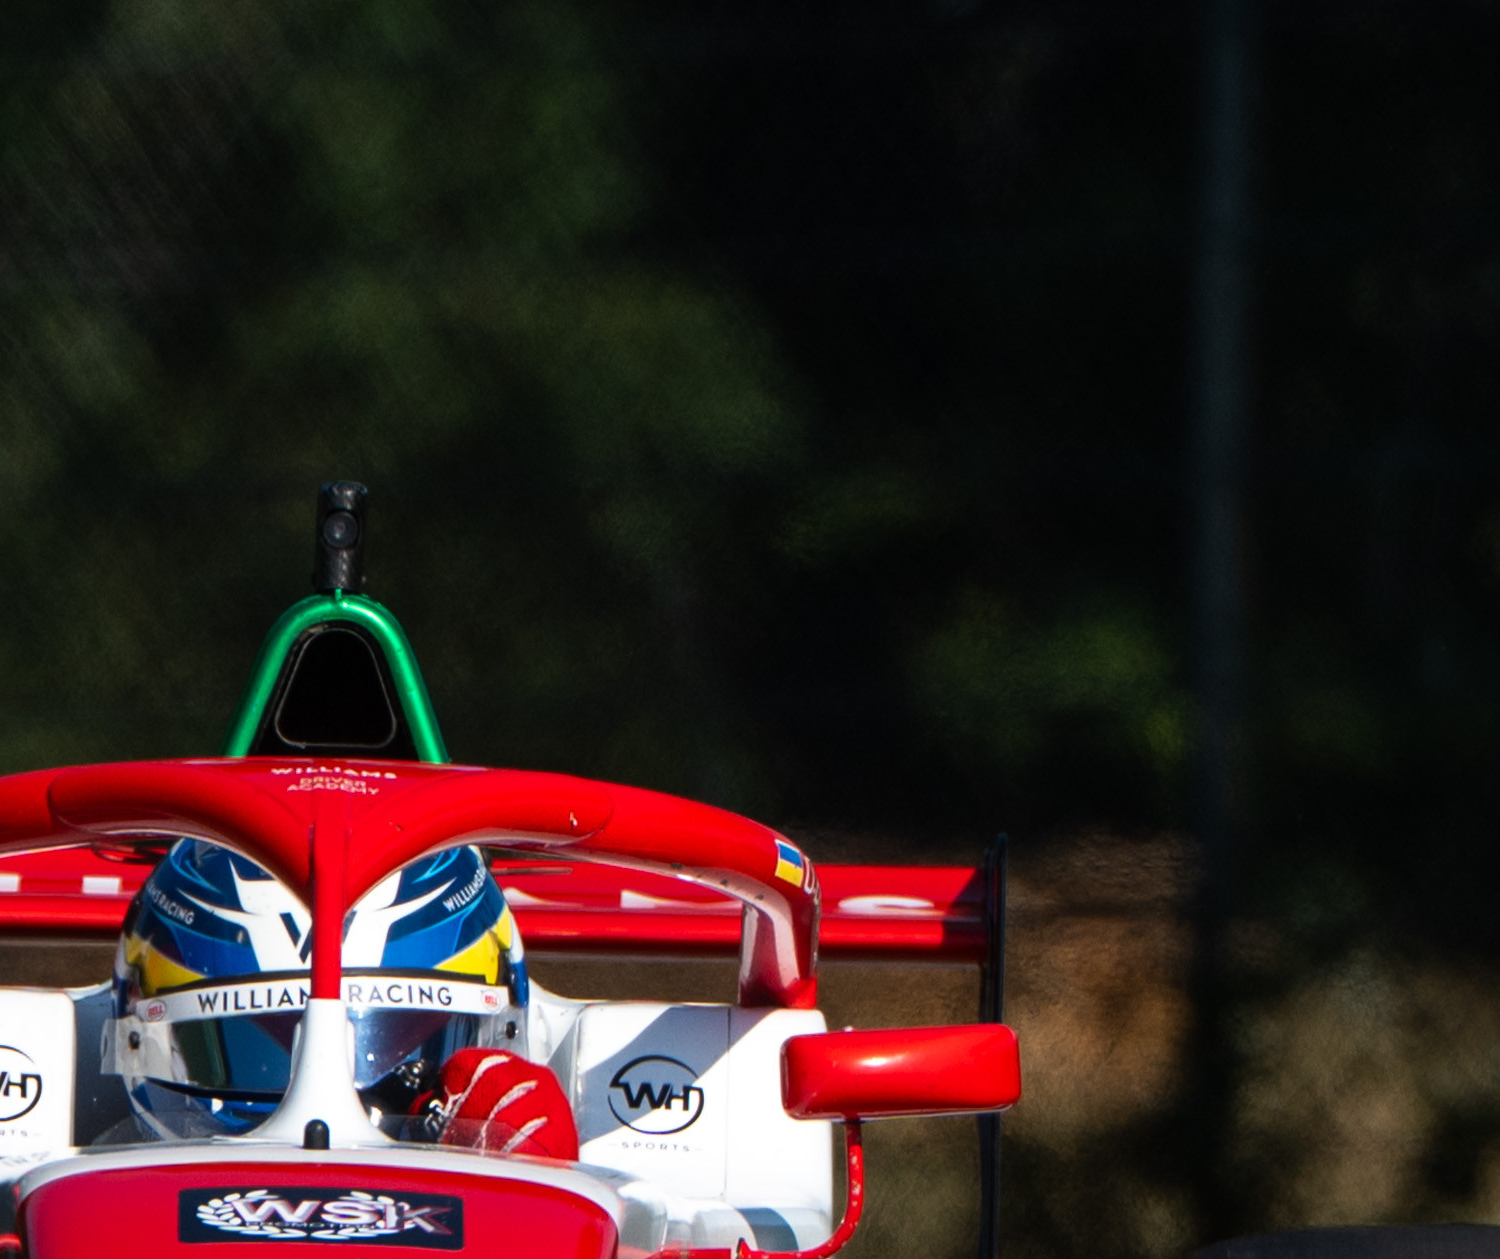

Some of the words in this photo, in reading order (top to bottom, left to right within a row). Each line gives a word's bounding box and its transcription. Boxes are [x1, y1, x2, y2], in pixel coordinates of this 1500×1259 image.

[271, 766, 397, 779] WILLIAMS
[300, 776, 367, 788] DRIVER
[287, 783, 379, 795] ACADEMY
[347, 984, 452, 1006] RACING
[621, 1141, 690, 1152] SPORTS
[231, 1199, 454, 1235] WSK
